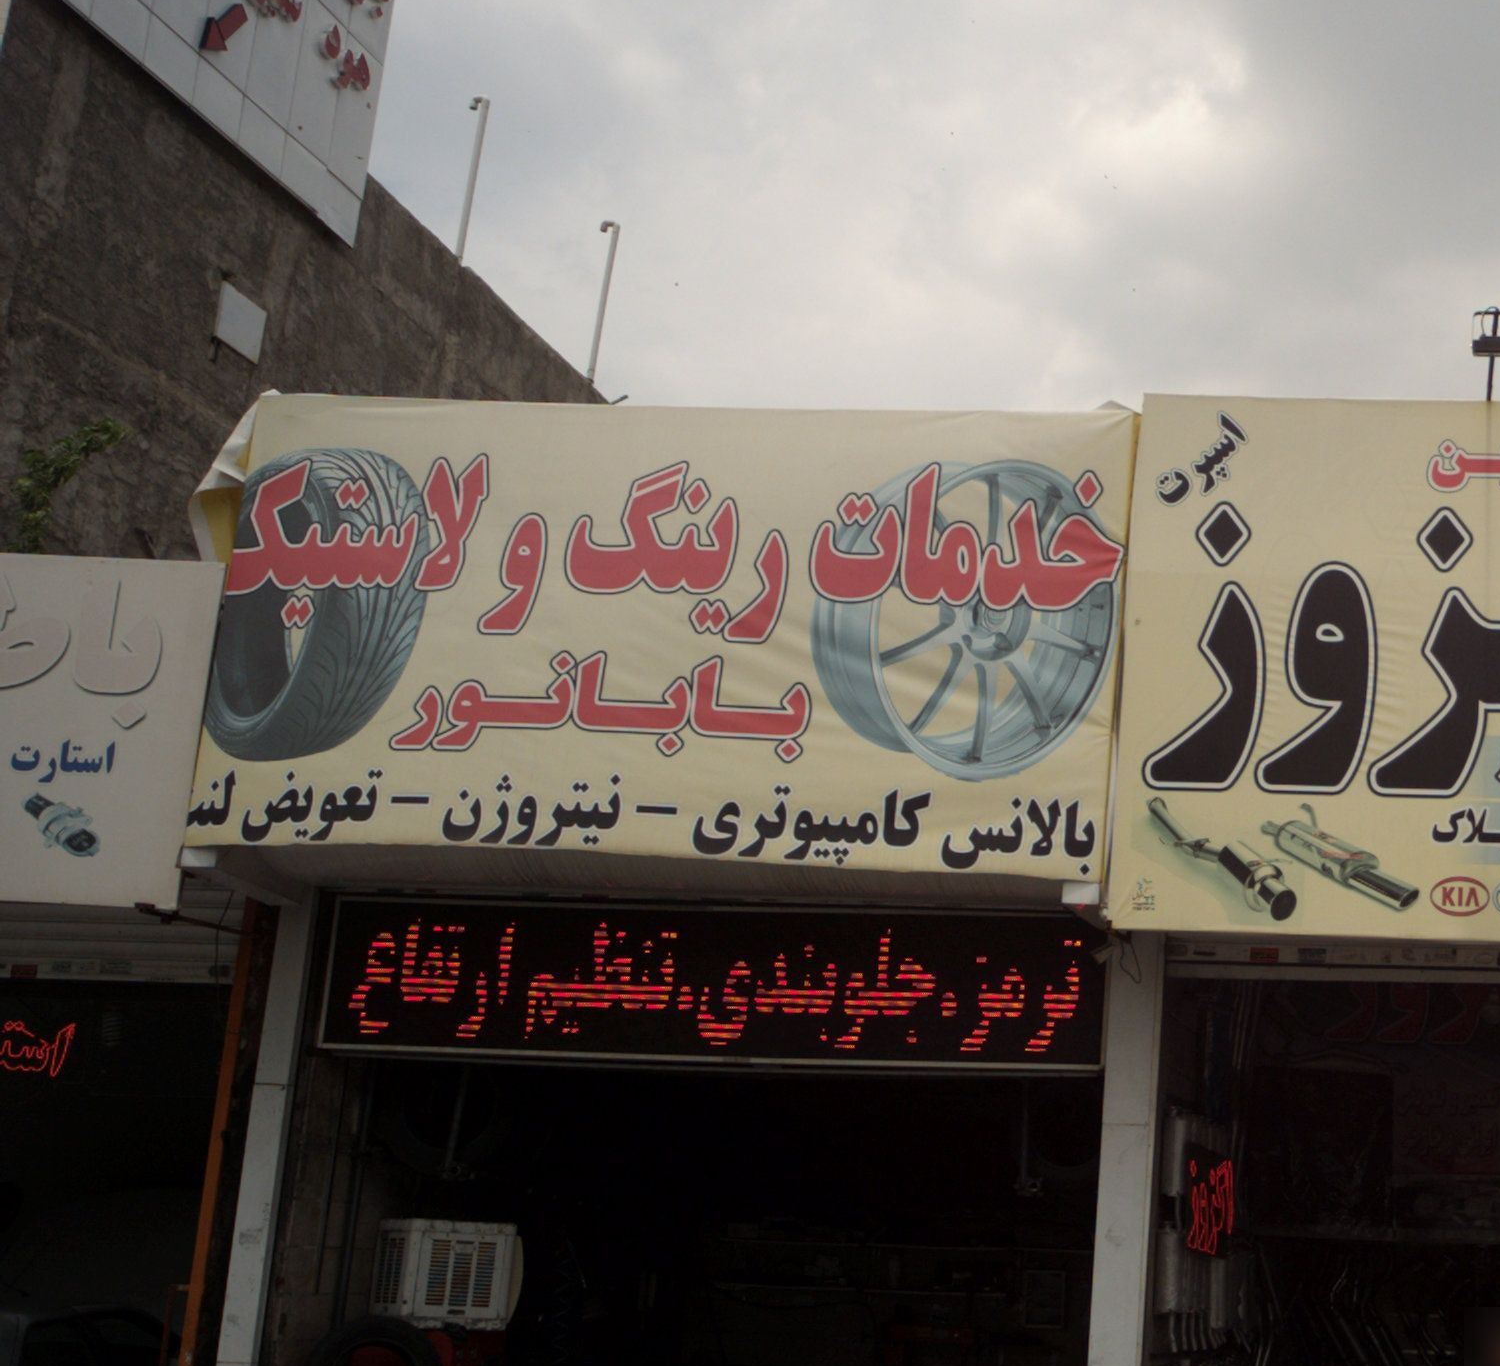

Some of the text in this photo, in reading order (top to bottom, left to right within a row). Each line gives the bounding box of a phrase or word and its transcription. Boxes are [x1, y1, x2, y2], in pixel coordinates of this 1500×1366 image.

[1156, 411, 1248, 506] اسپرت
[225, 453, 1127, 642] خدمات رینگ و لاستیک
[10, 739, 116, 785] استارت
[241, 767, 384, 843] تعویض
[441, 773, 623, 847] نیتروژن
[692, 785, 933, 866] کامپیوتری
[941, 795, 1097, 876] بالانس
[1441, 885, 1480, 909] KIA
